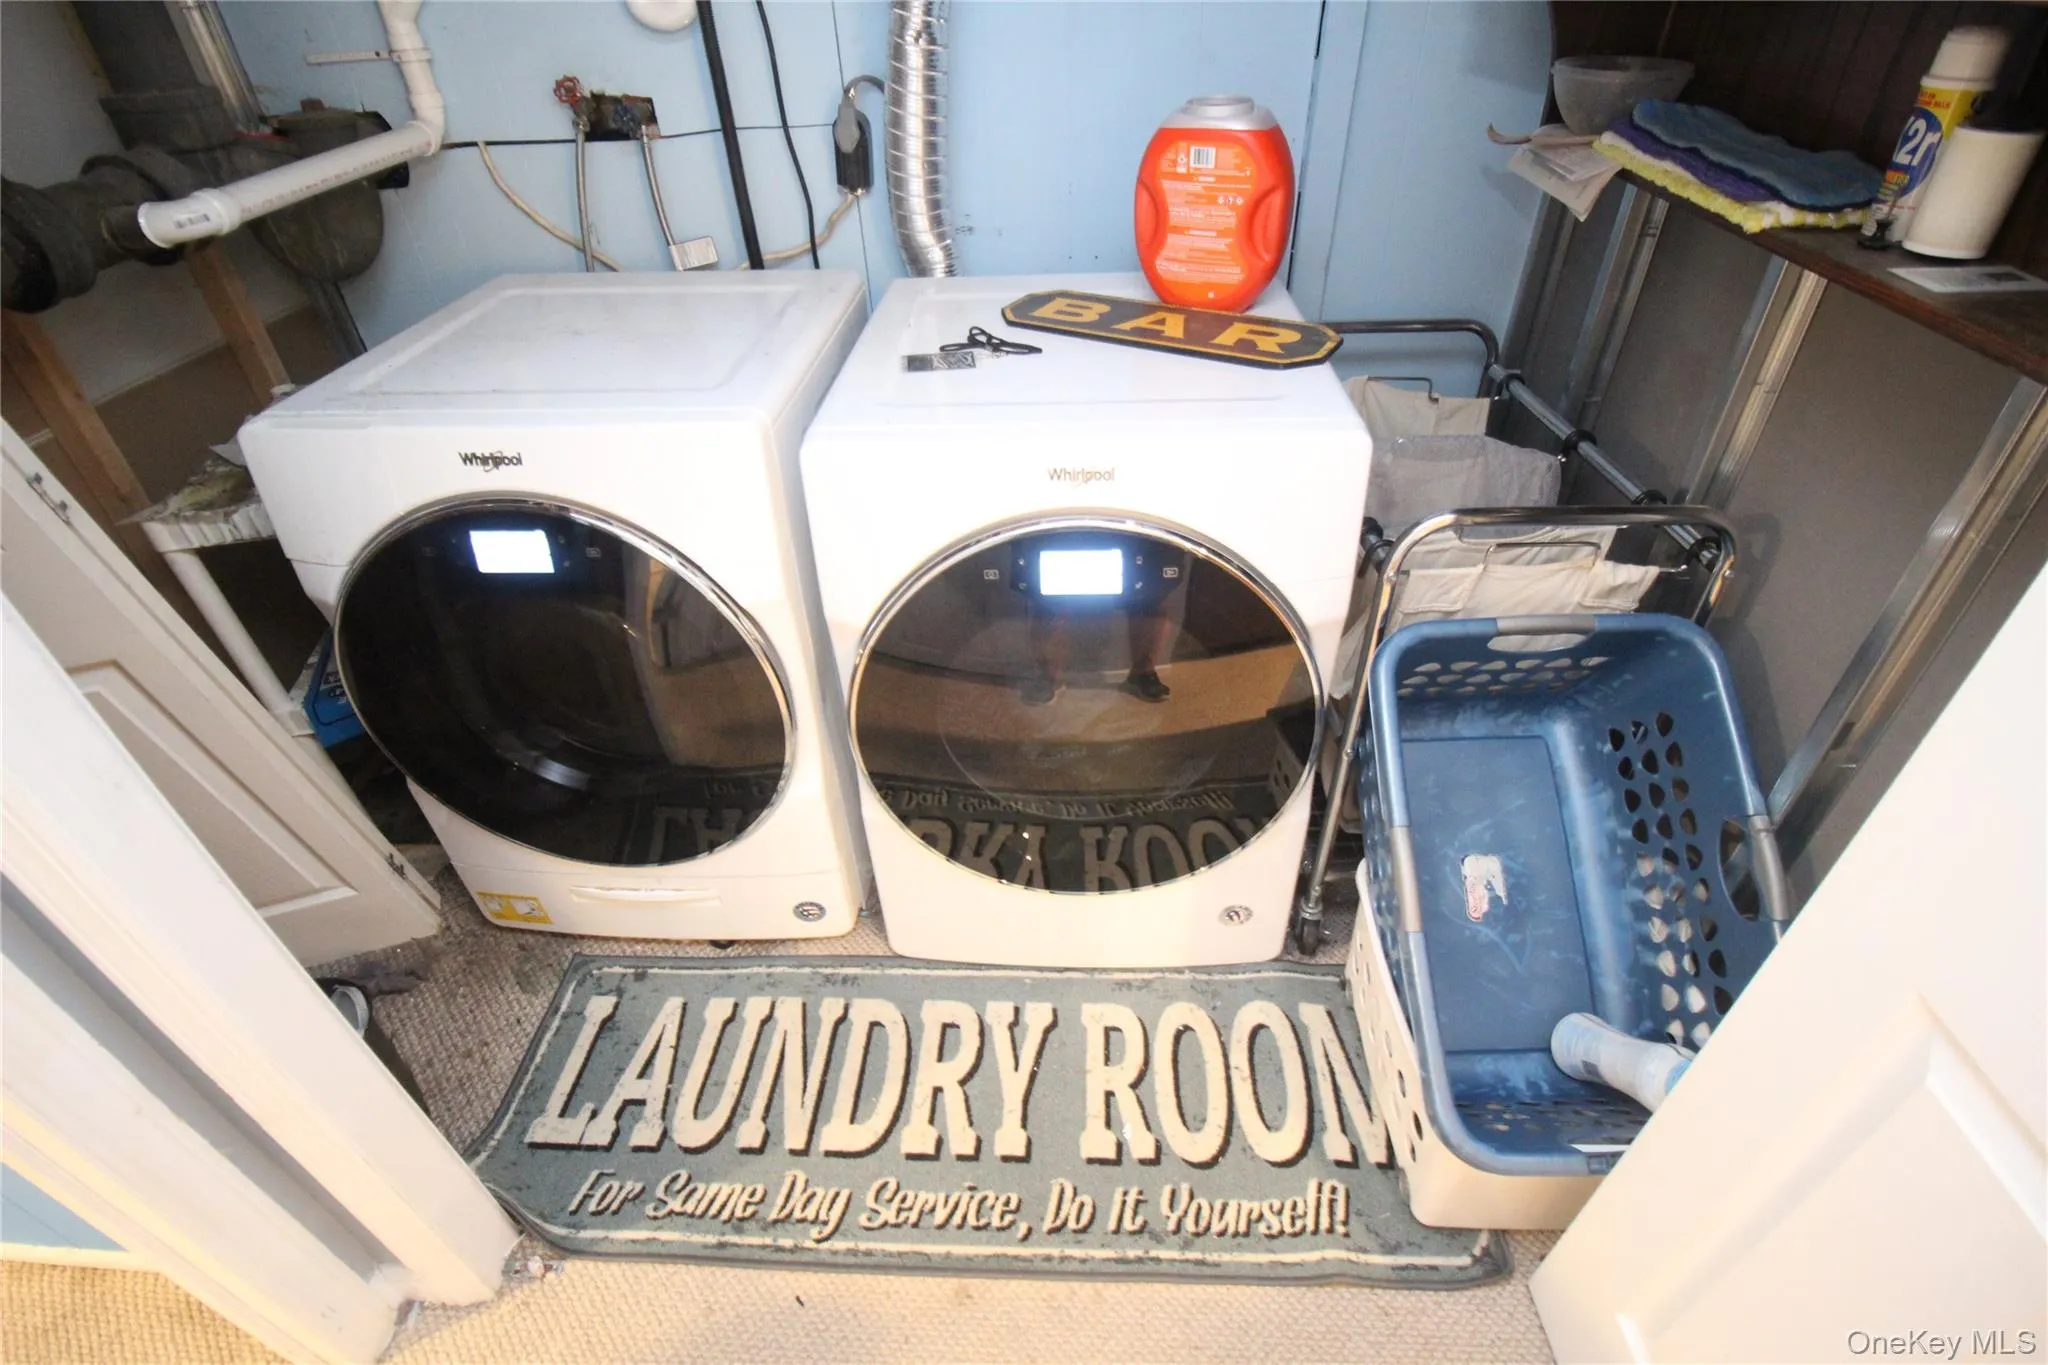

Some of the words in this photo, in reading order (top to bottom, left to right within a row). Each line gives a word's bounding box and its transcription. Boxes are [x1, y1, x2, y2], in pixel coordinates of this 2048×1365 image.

[1028, 298, 1302, 354] BAR
[458, 451, 523, 471] Whirlpool
[1047, 467, 1115, 485] Whirlpool
[524, 995, 1058, 1162] LAUNDRY
[568, 1168, 645, 1216] For
[645, 1169, 767, 1224] Same
[766, 1169, 852, 1243] Day
[858, 1176, 1032, 1242] Service,
[1042, 1177, 1096, 1235] Do
[1107, 1185, 1147, 1234] It
[1159, 1176, 1351, 1238] Yourself!
